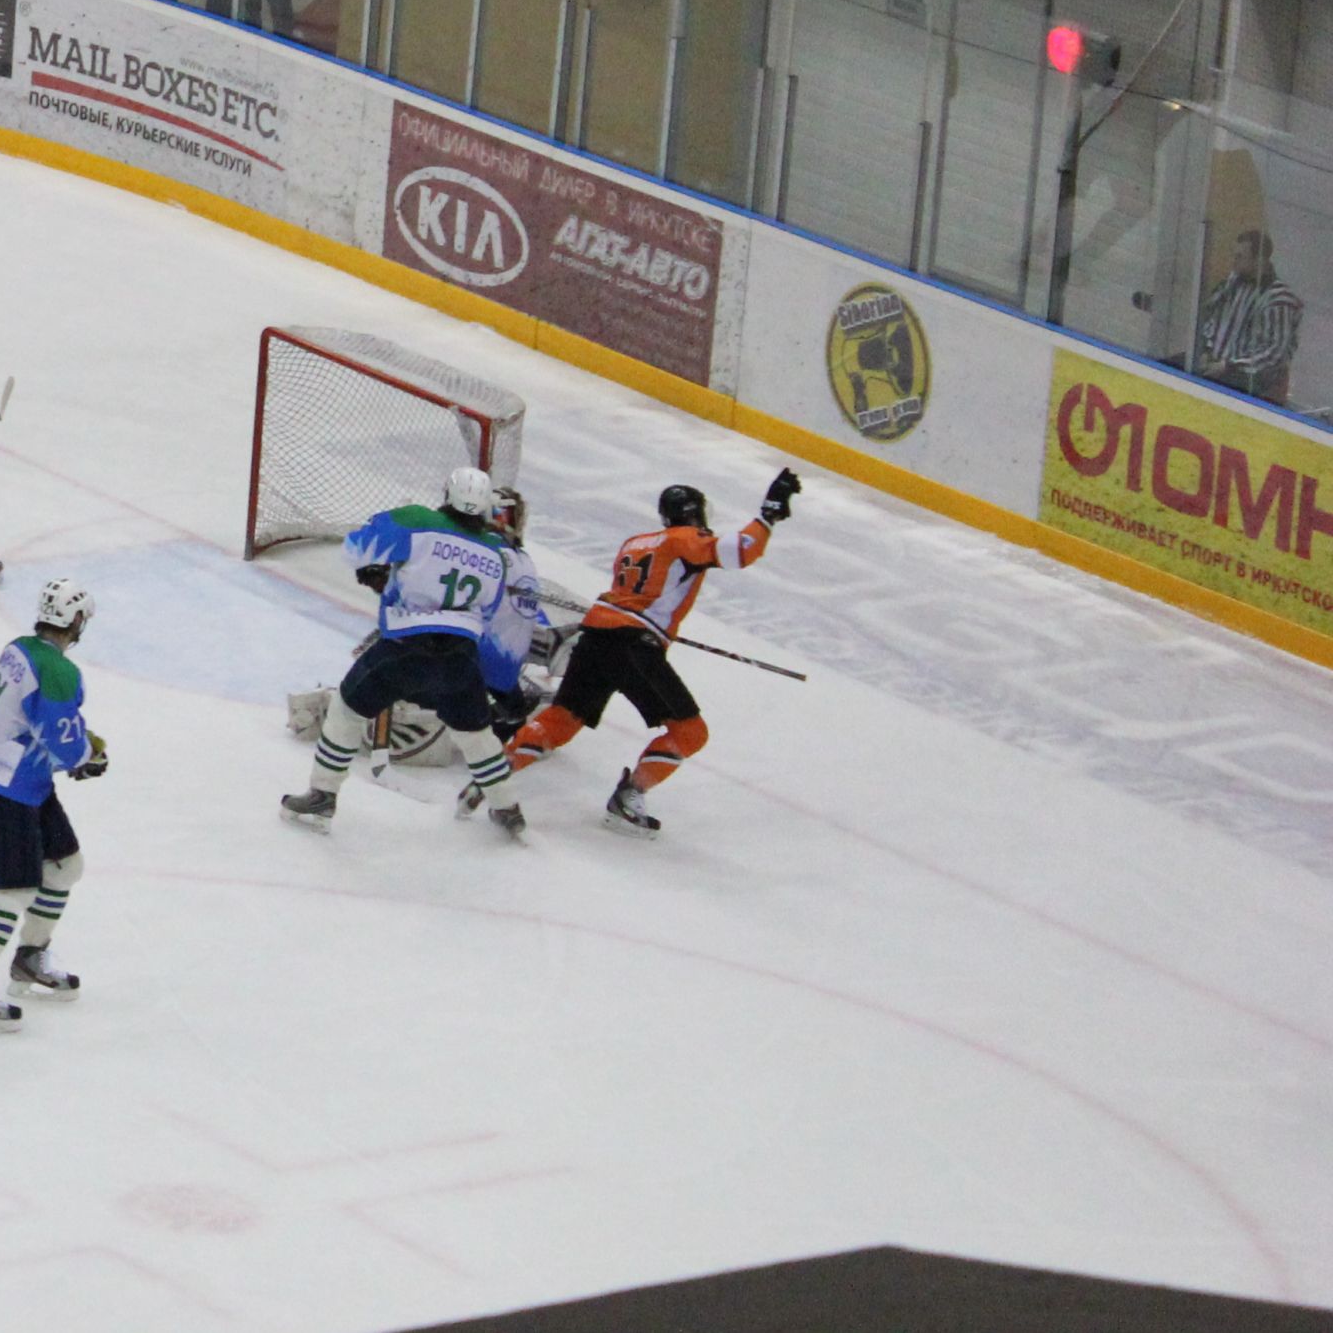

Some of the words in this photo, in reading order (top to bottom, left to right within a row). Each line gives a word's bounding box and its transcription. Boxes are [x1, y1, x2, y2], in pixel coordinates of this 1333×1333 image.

[27, 25, 117, 84] MAIL
[123, 54, 218, 117] BOXES
[222, 80, 280, 142] ETC.
[28, 91, 114, 130] ПОЧТОВЫЕ,
[116, 118, 202, 159] КУРЬЕРСКИЕ
[204, 144, 252, 177] УСЛУГИ
[417, 185, 505, 268] KIA
[433, 540, 502, 580] ДОРОФЕЕВ
[439, 567, 482, 612] 12
[57, 716, 83, 744] 21
